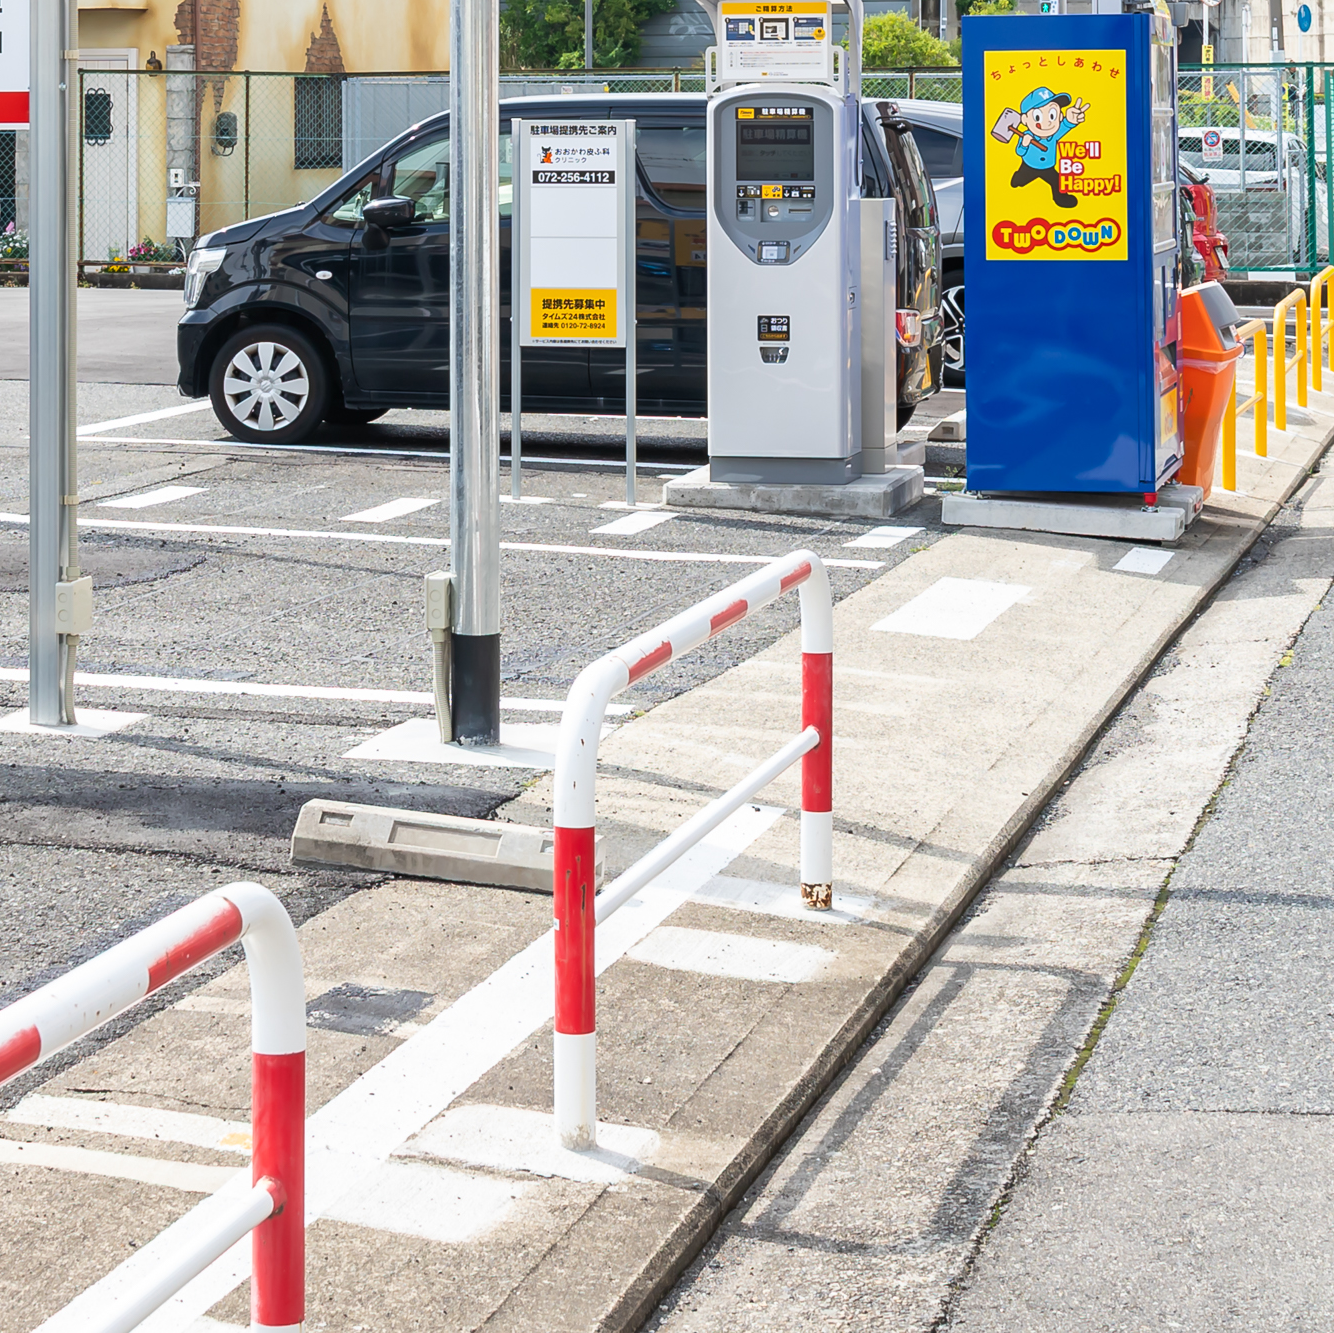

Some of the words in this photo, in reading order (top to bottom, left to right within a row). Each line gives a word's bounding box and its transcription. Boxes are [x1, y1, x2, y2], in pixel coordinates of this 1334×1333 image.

[990, 56, 1121, 81] ちょっとしあわせ
[530, 125, 617, 136] 駐車場提携先ご案内
[554, 148, 610, 156] おおかわ皮ふ科
[1060, 142, 1100, 158] We'll
[1060, 159, 1083, 174] Be
[538, 172, 610, 183] 072-256-4112
[1060, 175, 1121, 195] Happy!
[999, 224, 1046, 247] TWO
[1054, 224, 1113, 246] DOWN
[542, 298, 606, 310] 提携先募集中
[542, 313, 606, 321] タイムズ24株式会社
